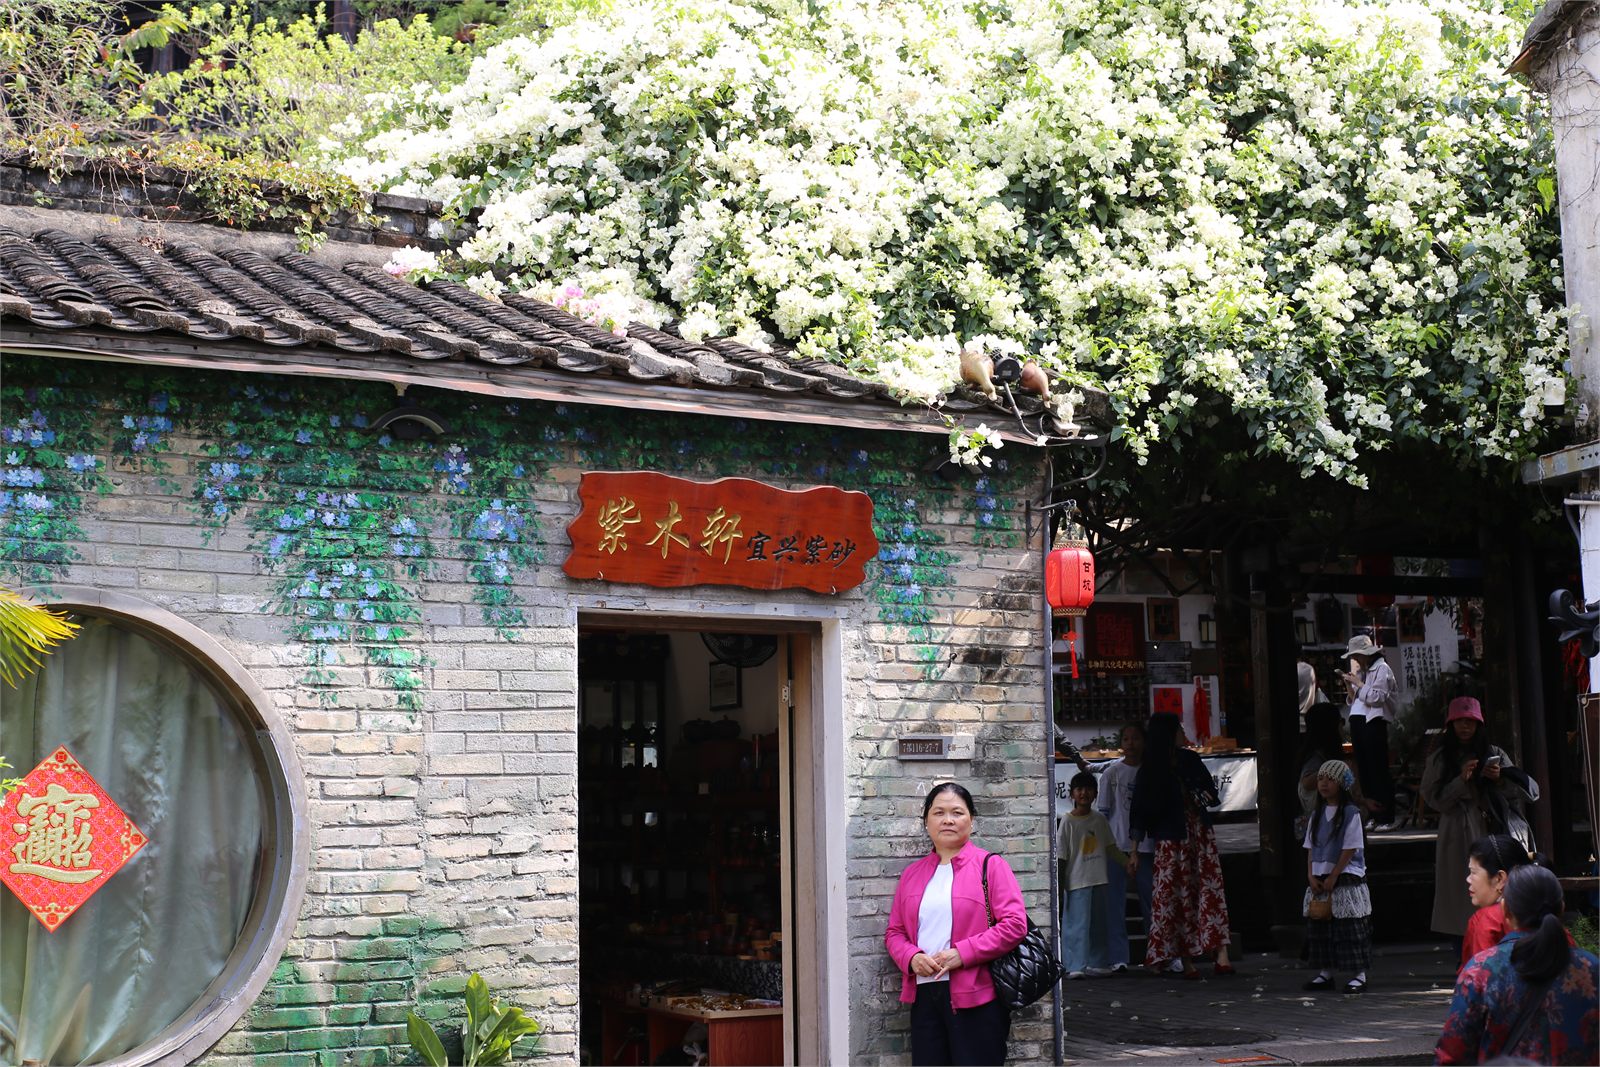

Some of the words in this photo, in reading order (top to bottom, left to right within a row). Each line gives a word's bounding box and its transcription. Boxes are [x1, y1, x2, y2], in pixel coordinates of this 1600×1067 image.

[597, 495, 744, 565] 紫木轩
[746, 530, 857, 568] 宜兴紫砂
[1082, 561, 1092, 591] 甘坑
